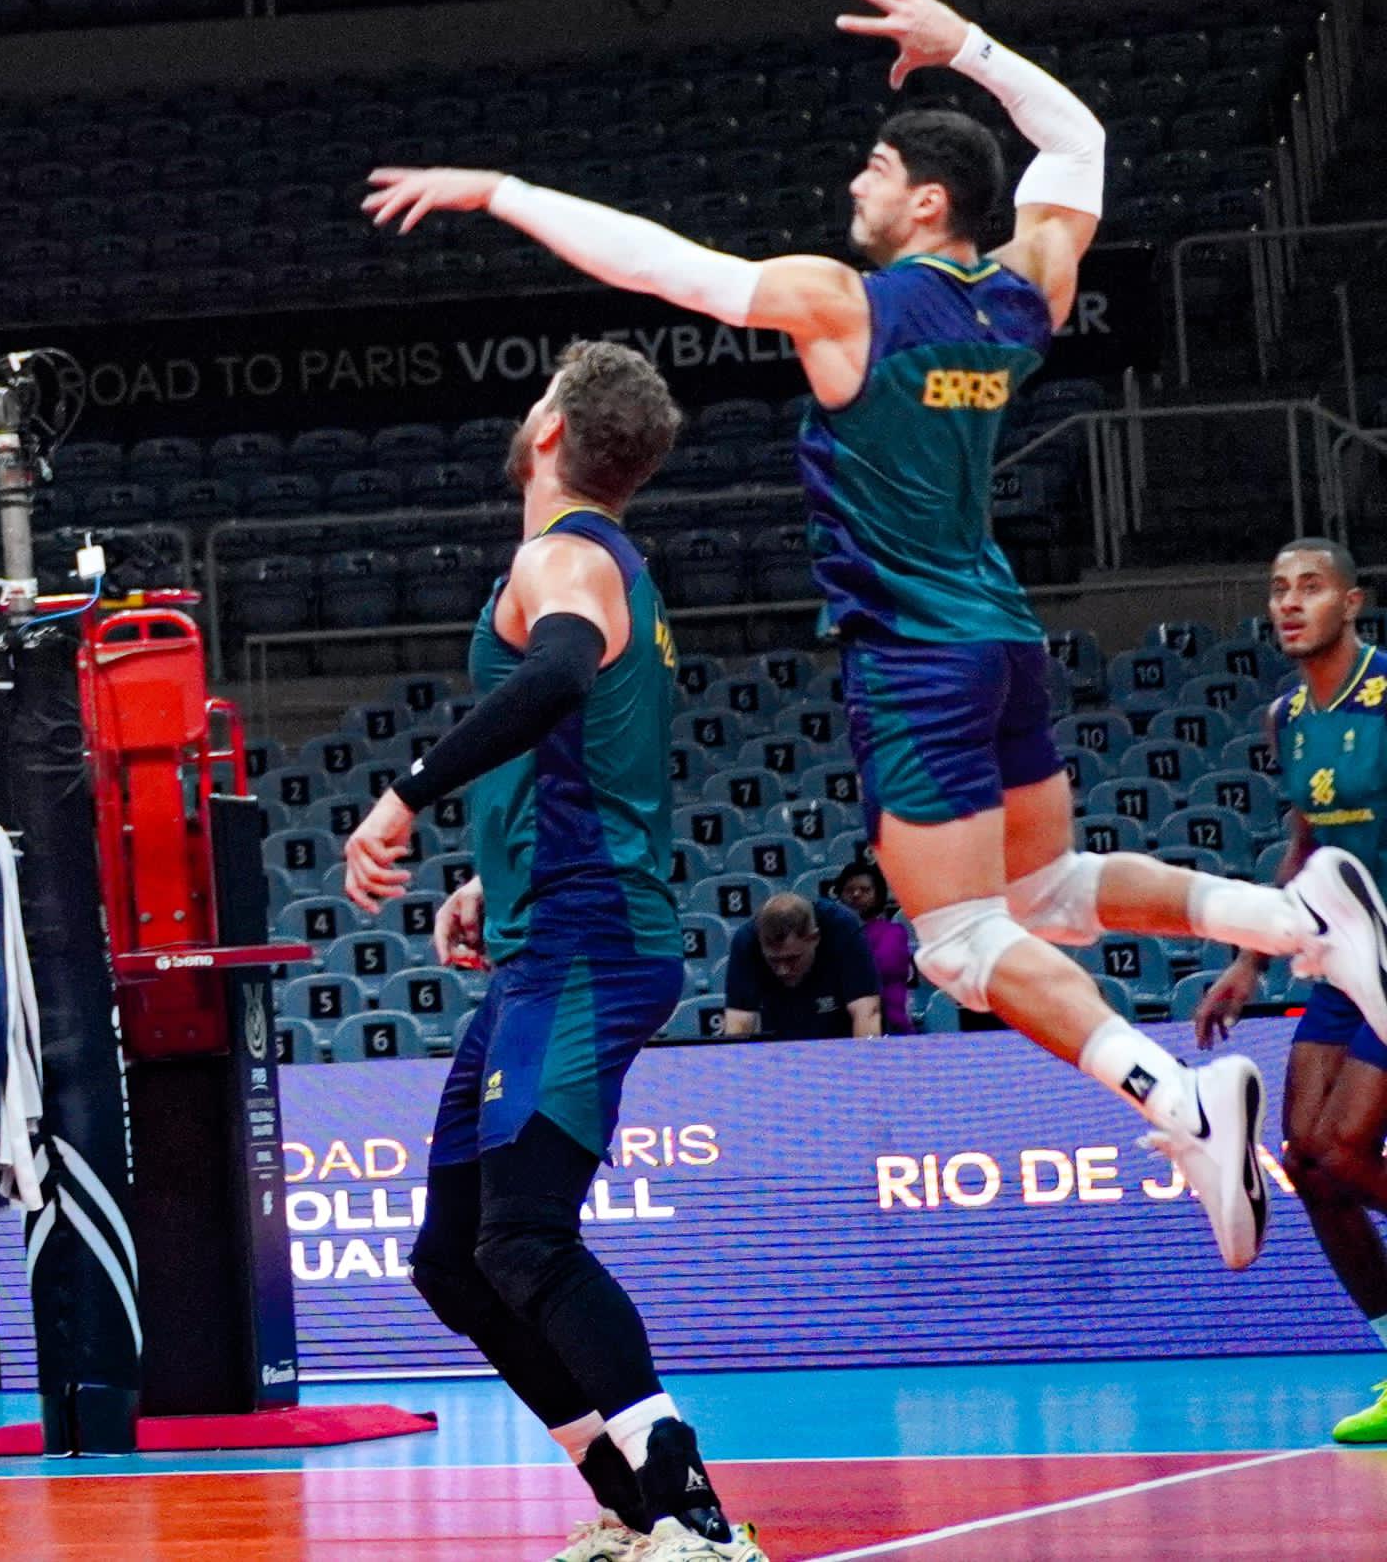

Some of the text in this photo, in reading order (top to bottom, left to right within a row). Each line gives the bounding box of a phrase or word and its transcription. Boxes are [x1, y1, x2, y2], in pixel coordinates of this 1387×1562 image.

[213, 352, 284, 397] TO
[298, 342, 444, 392] PARIS
[1137, 665, 1160, 681] 10
[1081, 728, 1105, 749] 10
[1182, 722, 1200, 742] 11
[1154, 755, 1173, 777] 11
[1123, 793, 1142, 814] 11
[1223, 788, 1245, 808] 12
[1093, 830, 1112, 851] 11
[1193, 824, 1217, 846] 12
[762, 850, 778, 872] 8
[728, 890, 743, 913] 8
[313, 913, 329, 934] 4
[412, 908, 427, 930] 5
[364, 947, 379, 969] 5
[1108, 949, 1134, 973] 12
[319, 990, 333, 1014] 5
[417, 984, 434, 1007] 6
[372, 1029, 389, 1052] 6
[282, 1124, 720, 1182] OAD RIS
[876, 1152, 1000, 1209] RIO
[1021, 1146, 1124, 1204] DE
